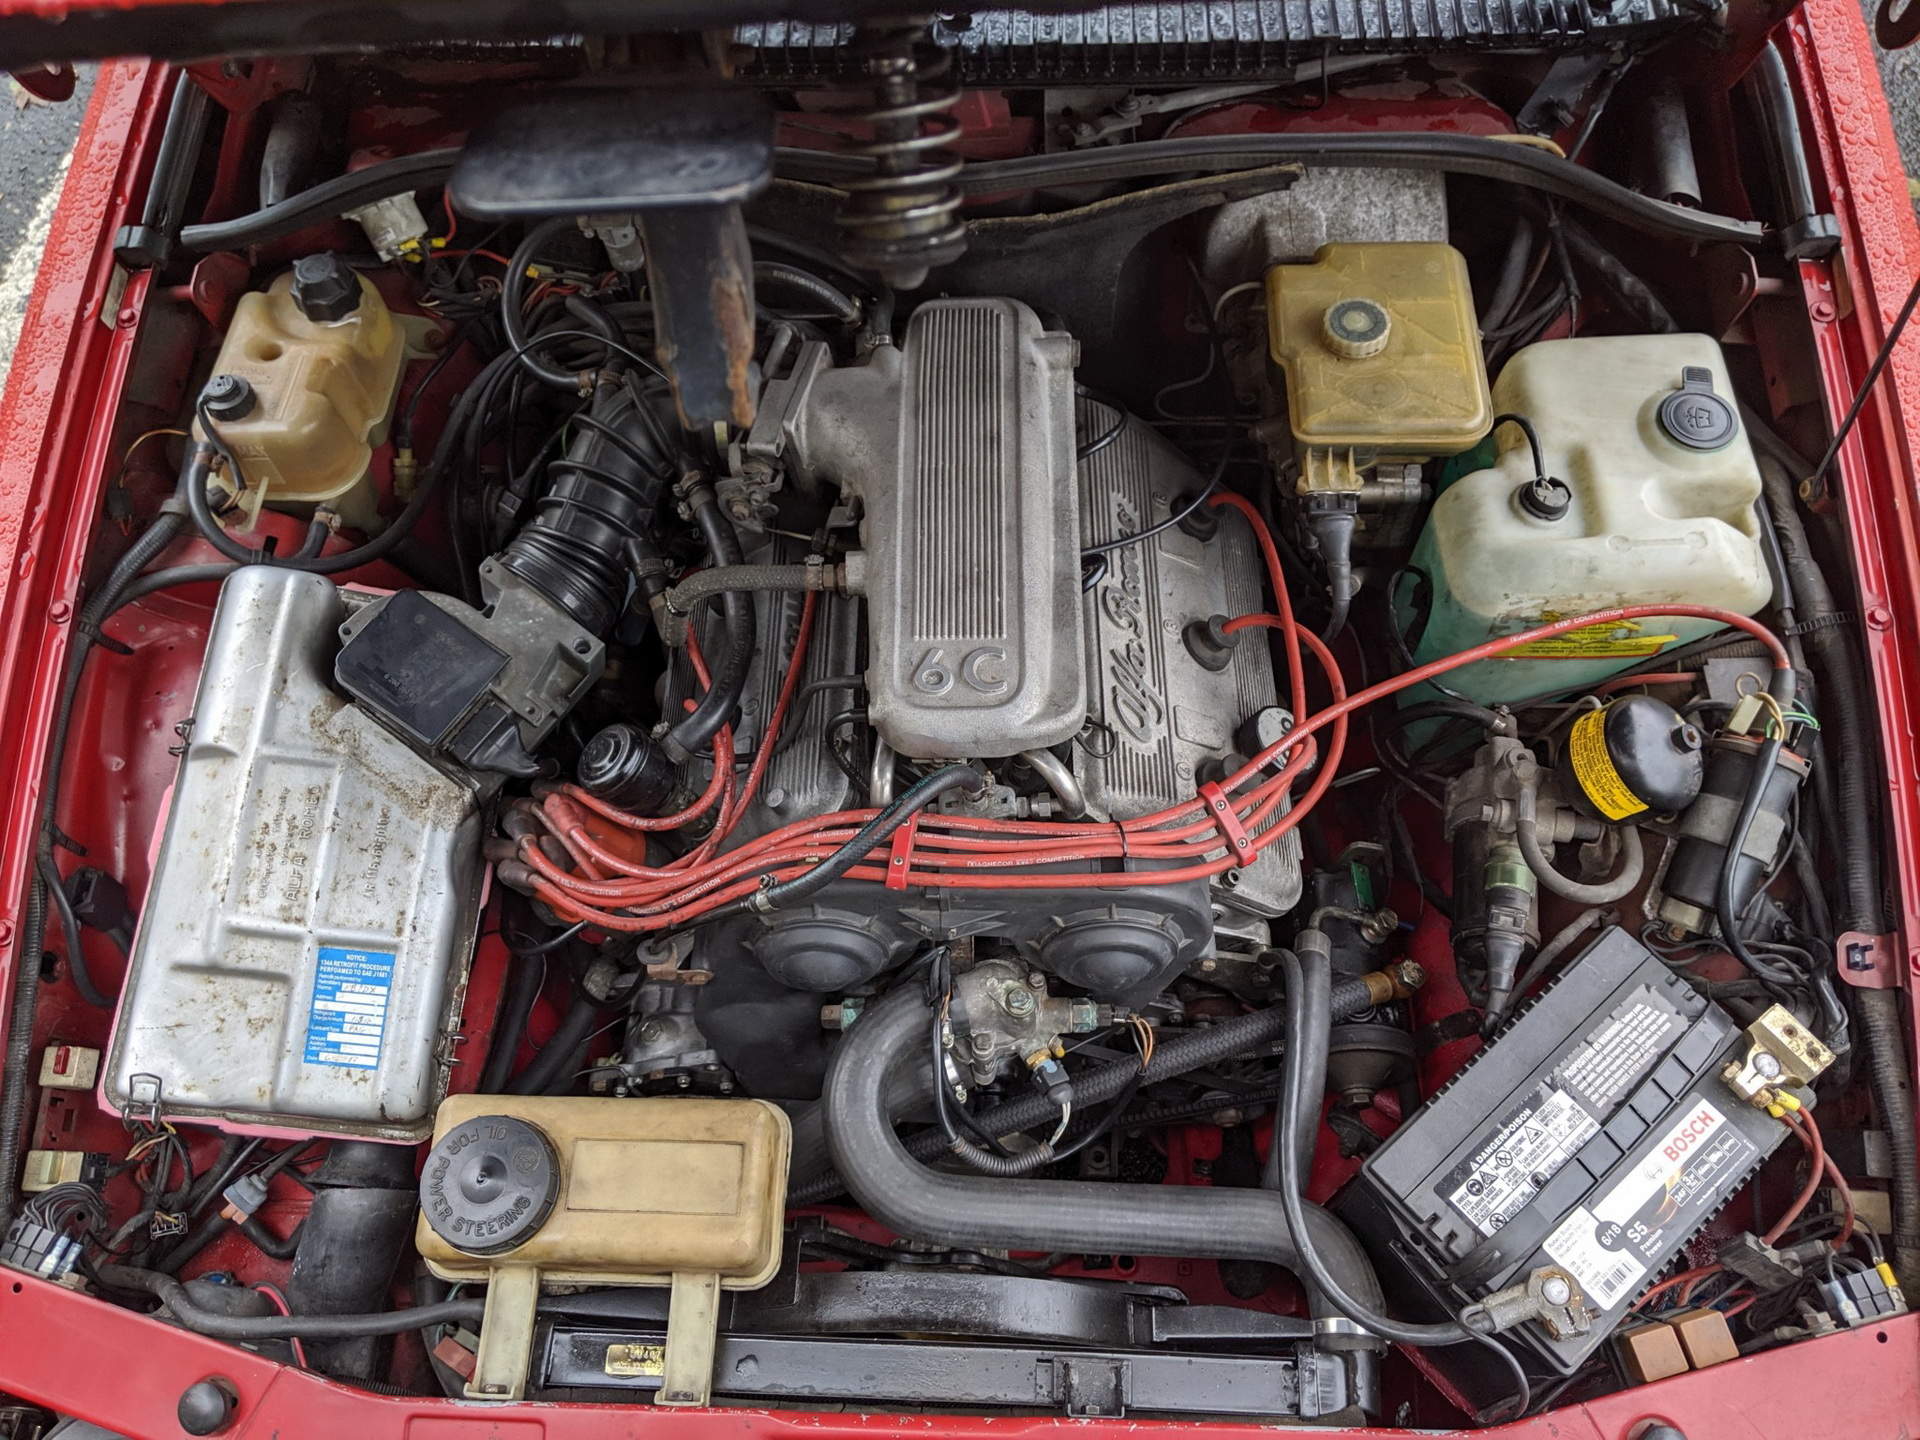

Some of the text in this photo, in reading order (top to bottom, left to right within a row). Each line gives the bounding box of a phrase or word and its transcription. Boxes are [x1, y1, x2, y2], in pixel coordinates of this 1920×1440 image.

[1573, 608, 1624, 623] COMPETITION
[1270, 726, 1311, 758] COMPETITION
[285, 782, 321, 901] ALFA ROMEO
[813, 828, 853, 839] MAGNECOR
[1036, 854, 1084, 864] COMPETITION
[675, 876, 723, 903] COMPETITION
[319, 965, 353, 975] PERFORMED
[333, 959, 358, 968] RETROFIT
[358, 962, 390, 972] PROCEDURE
[345, 953, 368, 962] NOTICE:
[1596, 1018, 1625, 1046] WARNING:
[1591, 1040, 1602, 1051] 65
[1561, 1046, 1597, 1080] PROPOSITION
[1604, 1082, 1620, 1097] WASH
[1615, 1071, 1631, 1087] HANDS
[1626, 1061, 1641, 1076] AFTER
[1474, 1106, 1533, 1164] DANGER/POISON
[1661, 1109, 1716, 1163] BOSCH
[430, 1125, 531, 1237] OIL FOR POWER STEERING
[1681, 1174, 1692, 1186] 3
[1454, 1190, 1470, 1205] SHIELD
[1673, 1187, 1688, 1202] 24F
[1598, 1222, 1623, 1247] 6/18
[1624, 1218, 1650, 1244] S5
[1637, 1226, 1664, 1252] Premium
[1644, 1238, 1665, 1258] Power
